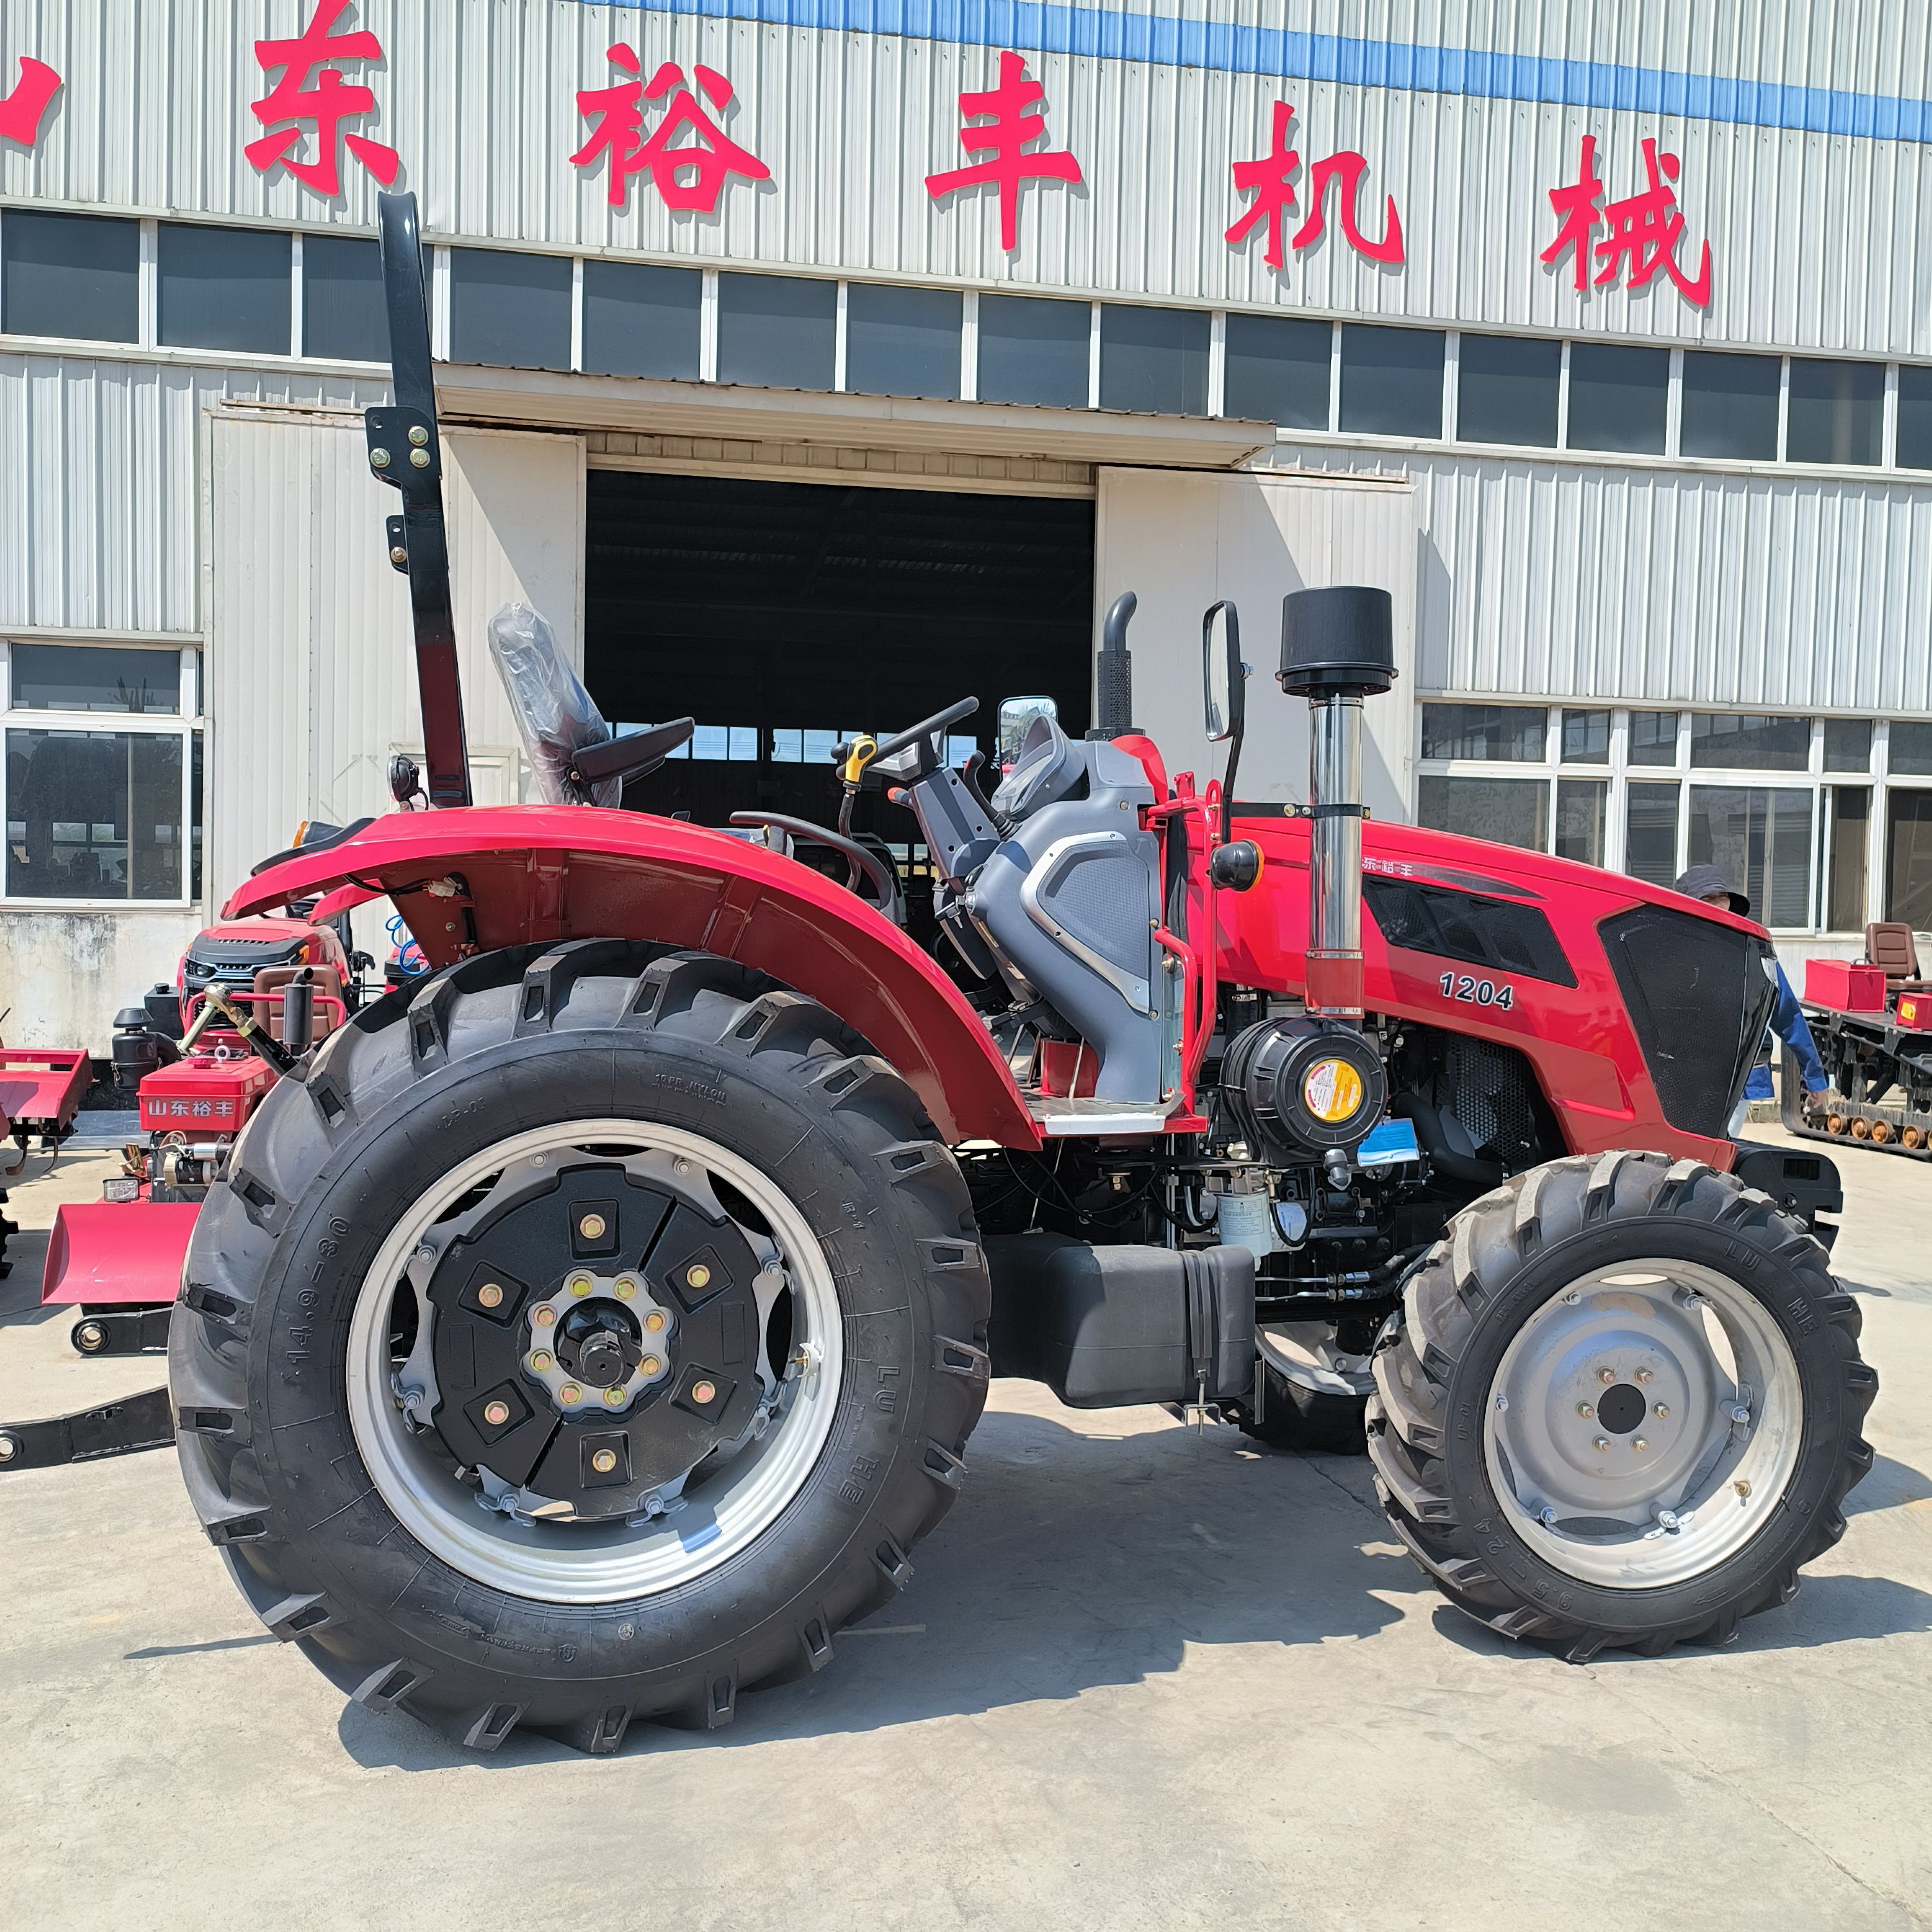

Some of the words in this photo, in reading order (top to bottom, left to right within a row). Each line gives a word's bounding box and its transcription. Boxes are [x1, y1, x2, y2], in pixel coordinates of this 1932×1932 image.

[1439, 971, 1513, 1011] 1204
[148, 1099, 234, 1118] 山东裕丰
[286, 1216, 351, 1364] 14.9-30
[875, 1365, 900, 1414] LU
[838, 1454, 876, 1504] HE
[1473, 1517, 1573, 1611] 9.5-24
